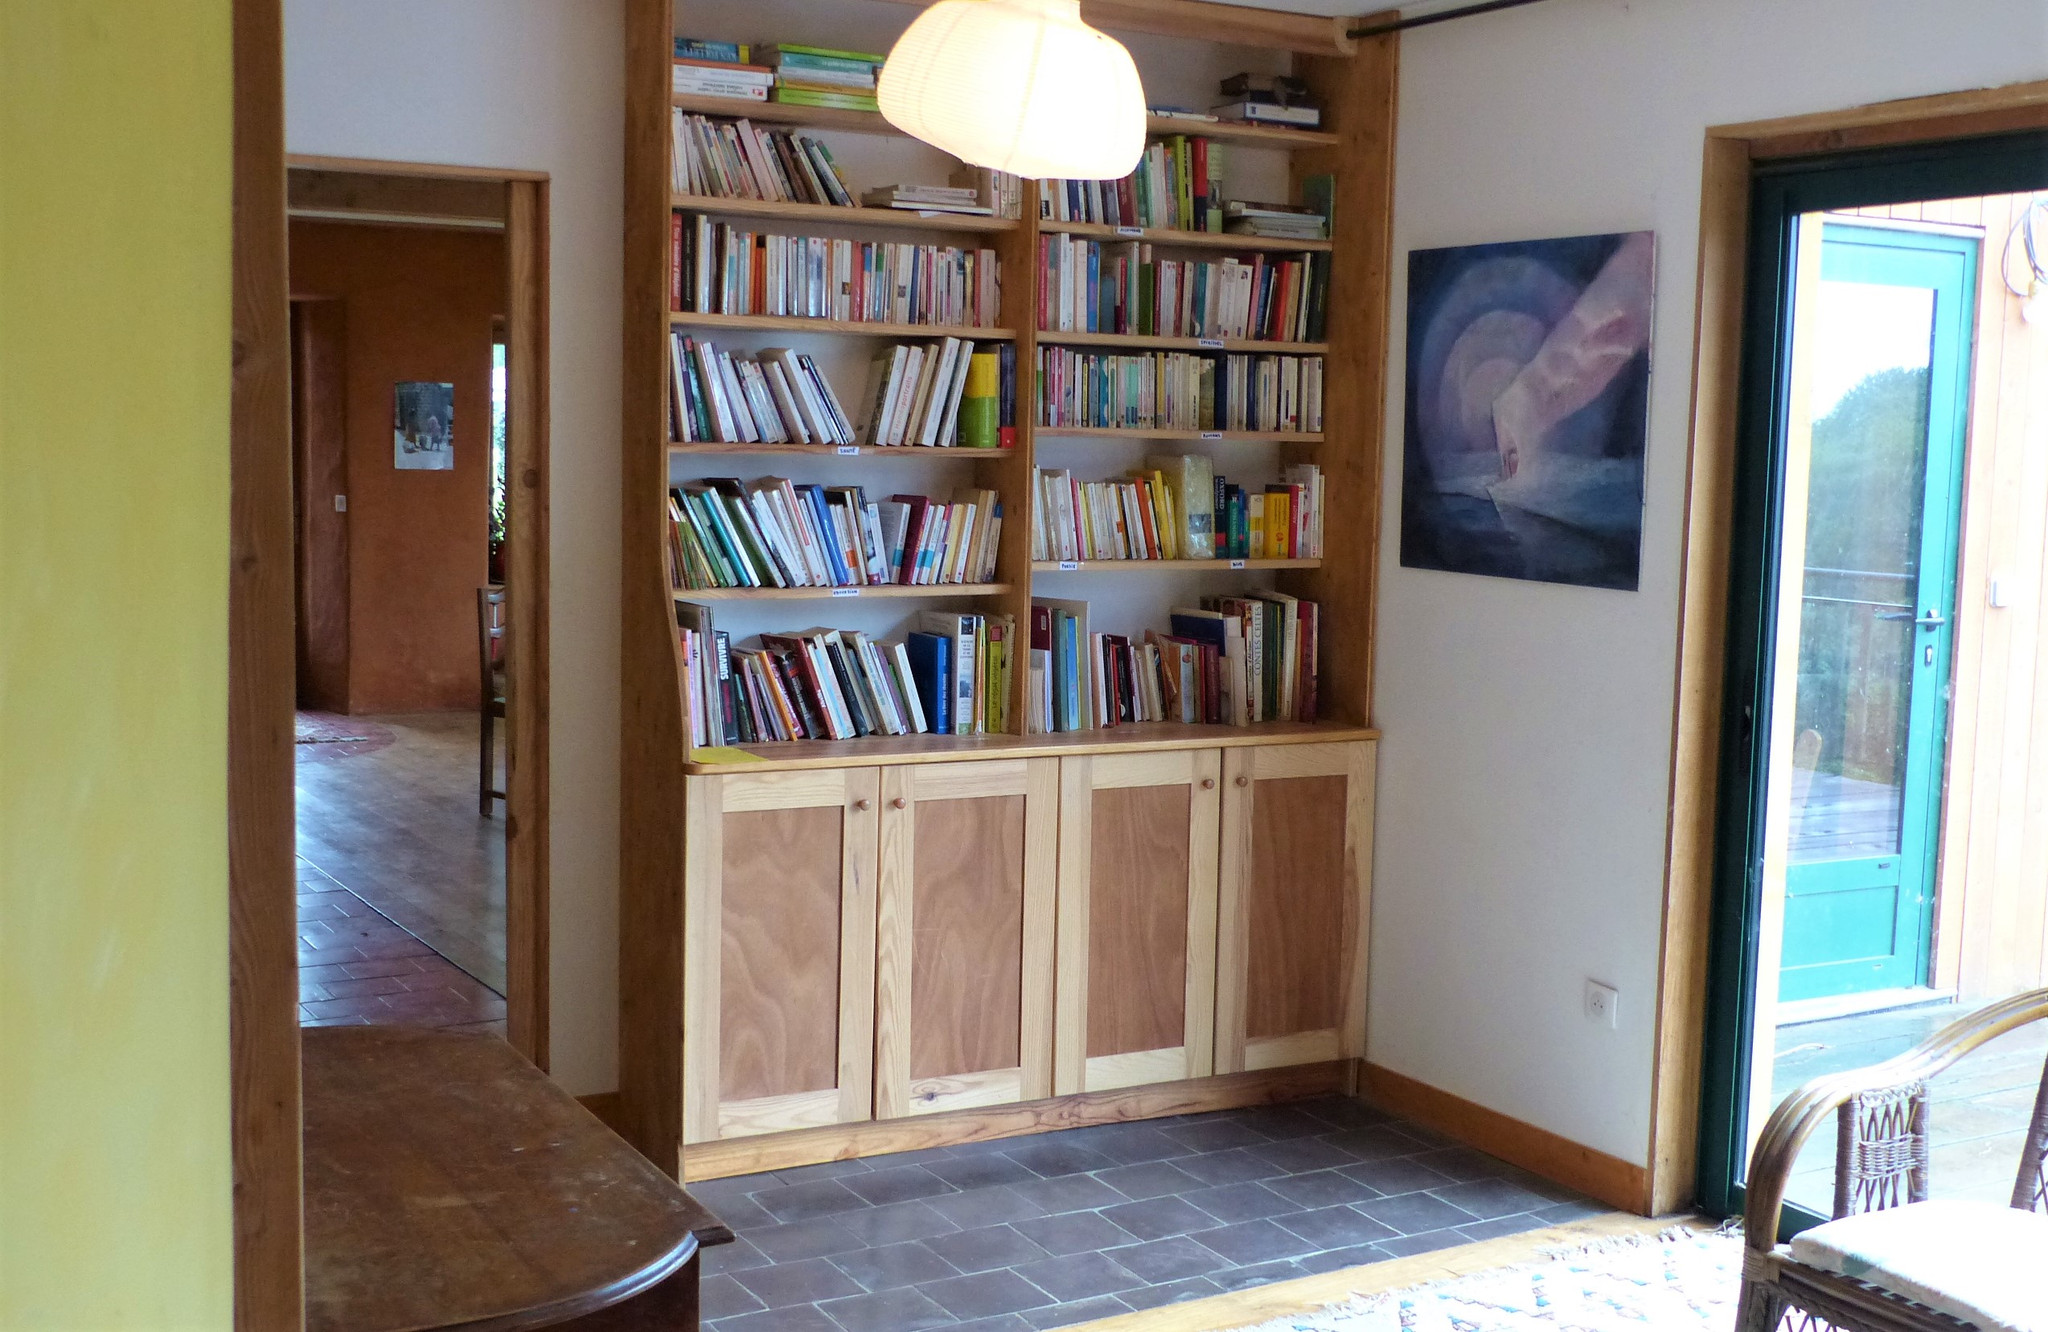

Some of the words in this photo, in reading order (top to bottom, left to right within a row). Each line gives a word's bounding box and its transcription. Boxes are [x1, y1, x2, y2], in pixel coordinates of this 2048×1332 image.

[1254, 606, 1262, 638] CELTES
[717, 637, 729, 680] SURVIVRE
[1254, 640, 1262, 676] CONTES
